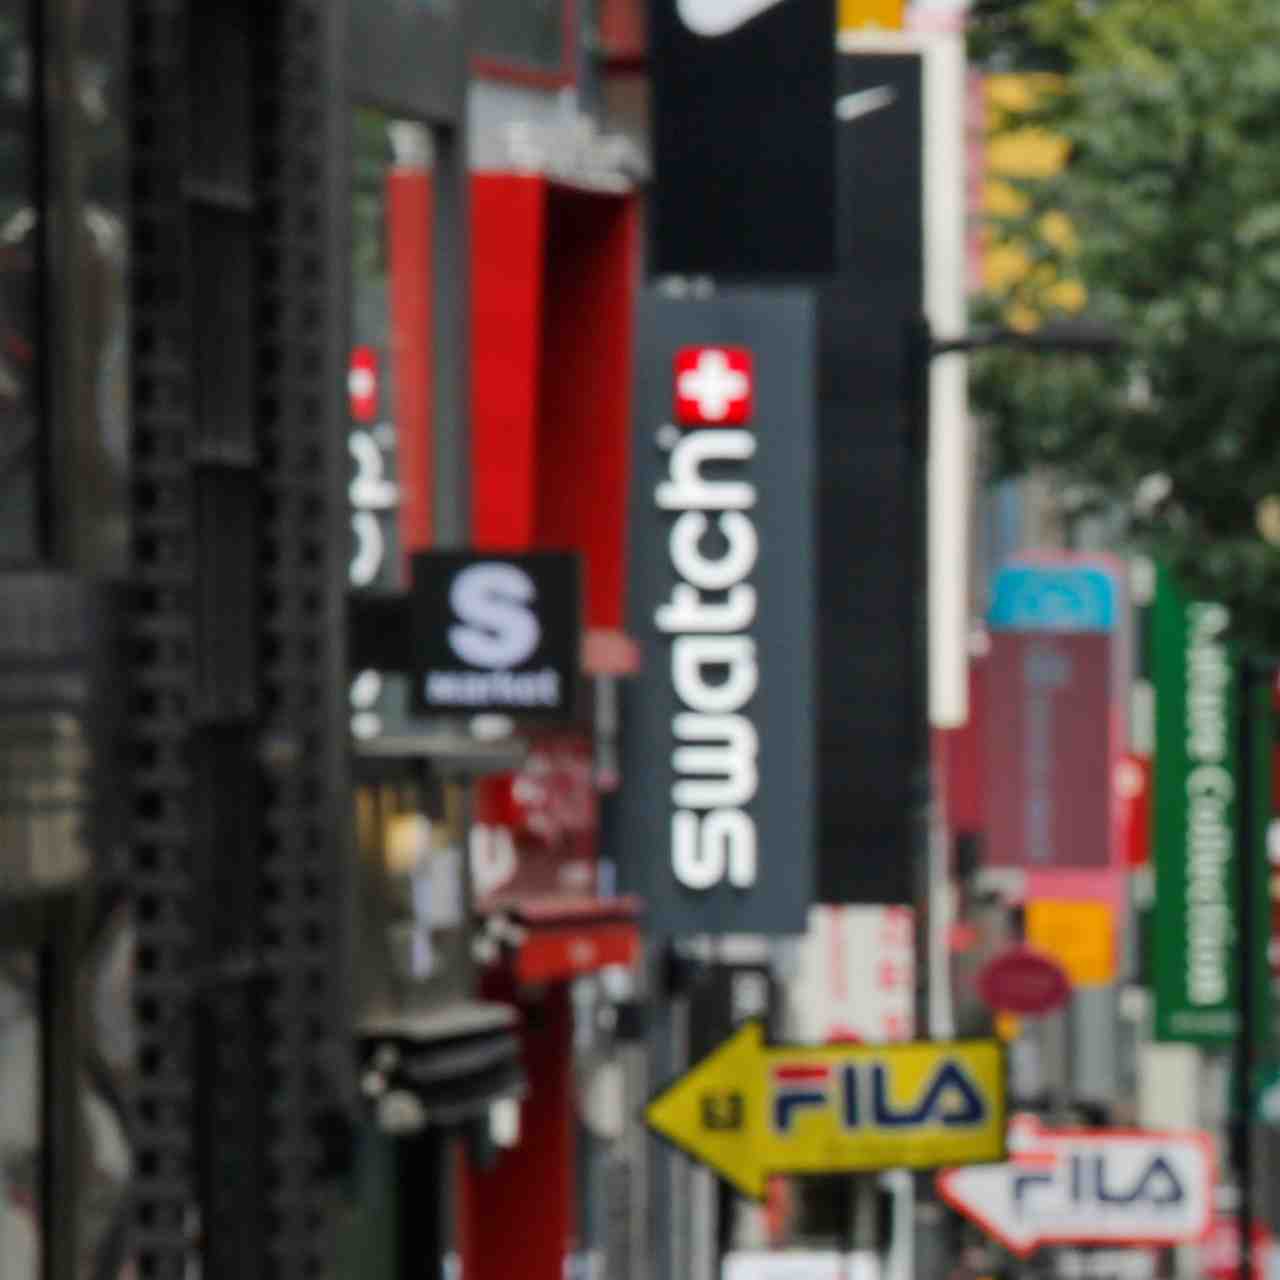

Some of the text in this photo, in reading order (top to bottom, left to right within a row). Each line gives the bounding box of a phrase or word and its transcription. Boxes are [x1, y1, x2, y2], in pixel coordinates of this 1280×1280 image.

[447, 561, 540, 668] S
[655, 429, 758, 889] swatch
[773, 1061, 986, 1133] FILA
[1008, 1151, 1186, 1207] FILA
